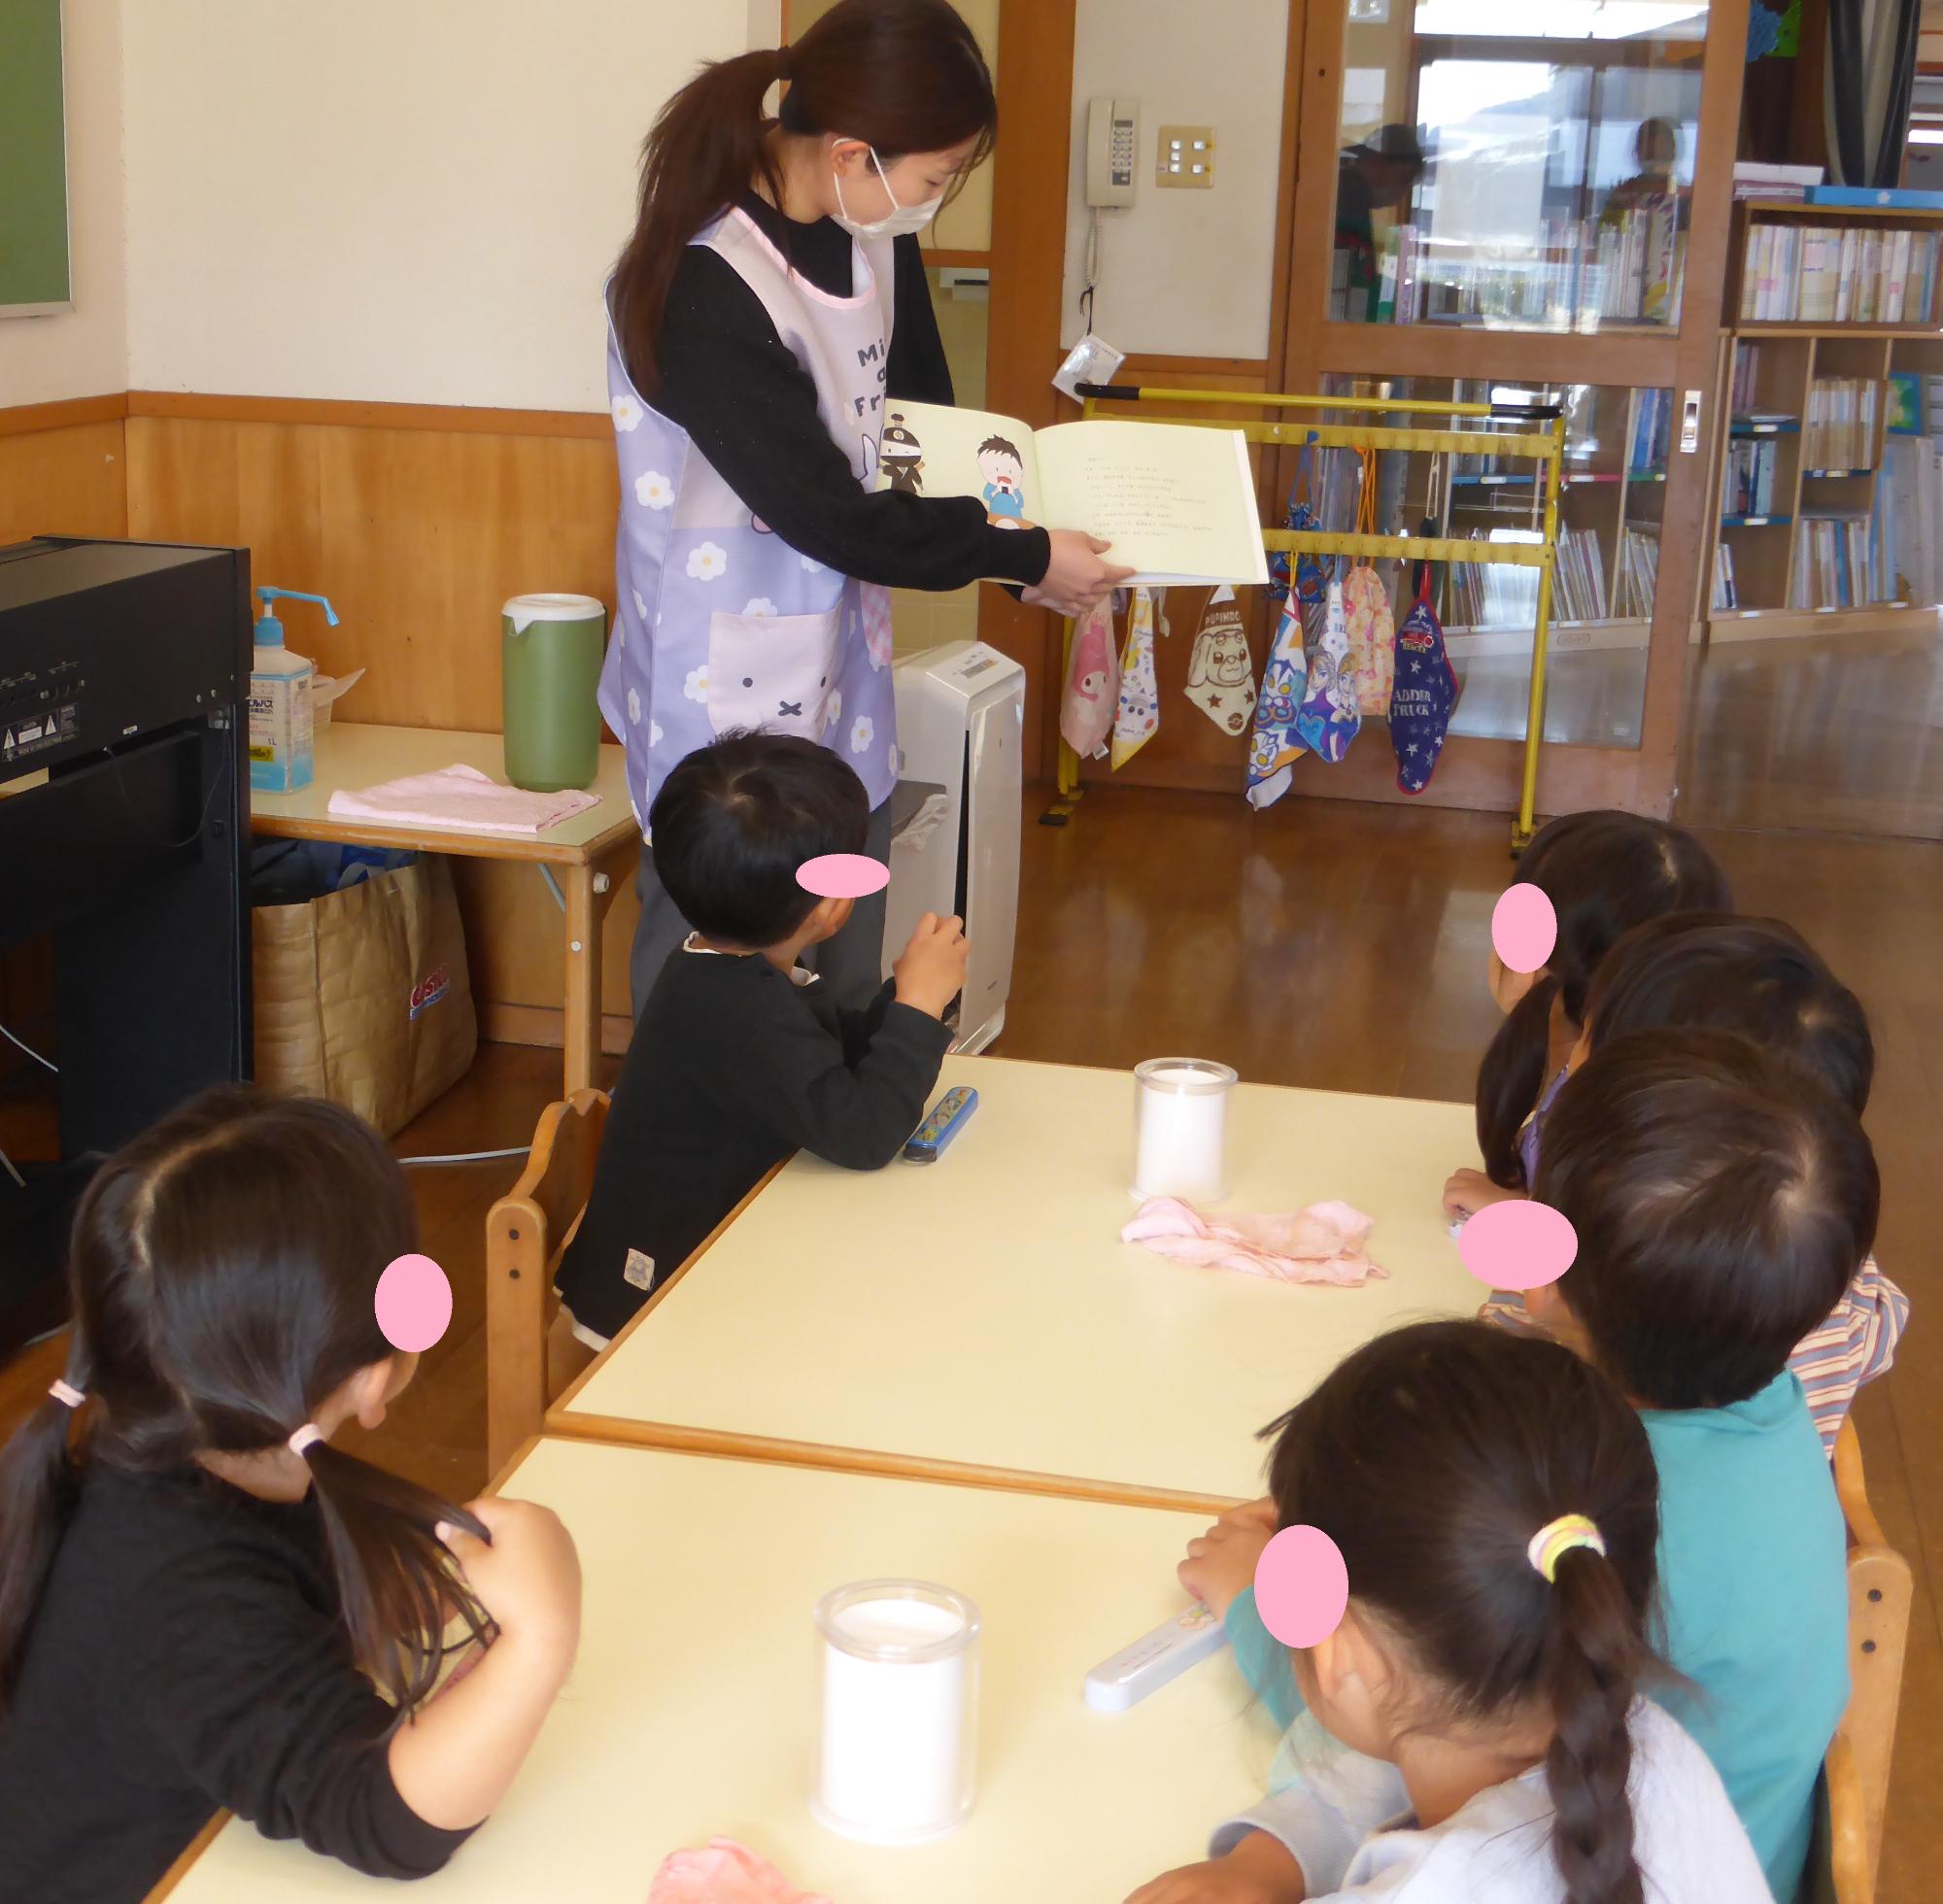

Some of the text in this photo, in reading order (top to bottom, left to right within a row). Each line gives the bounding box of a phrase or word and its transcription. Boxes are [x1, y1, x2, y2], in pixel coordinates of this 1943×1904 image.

[857, 339, 885, 367] Mi
[876, 366, 886, 383] a
[1395, 689, 1431, 701] ADDER
